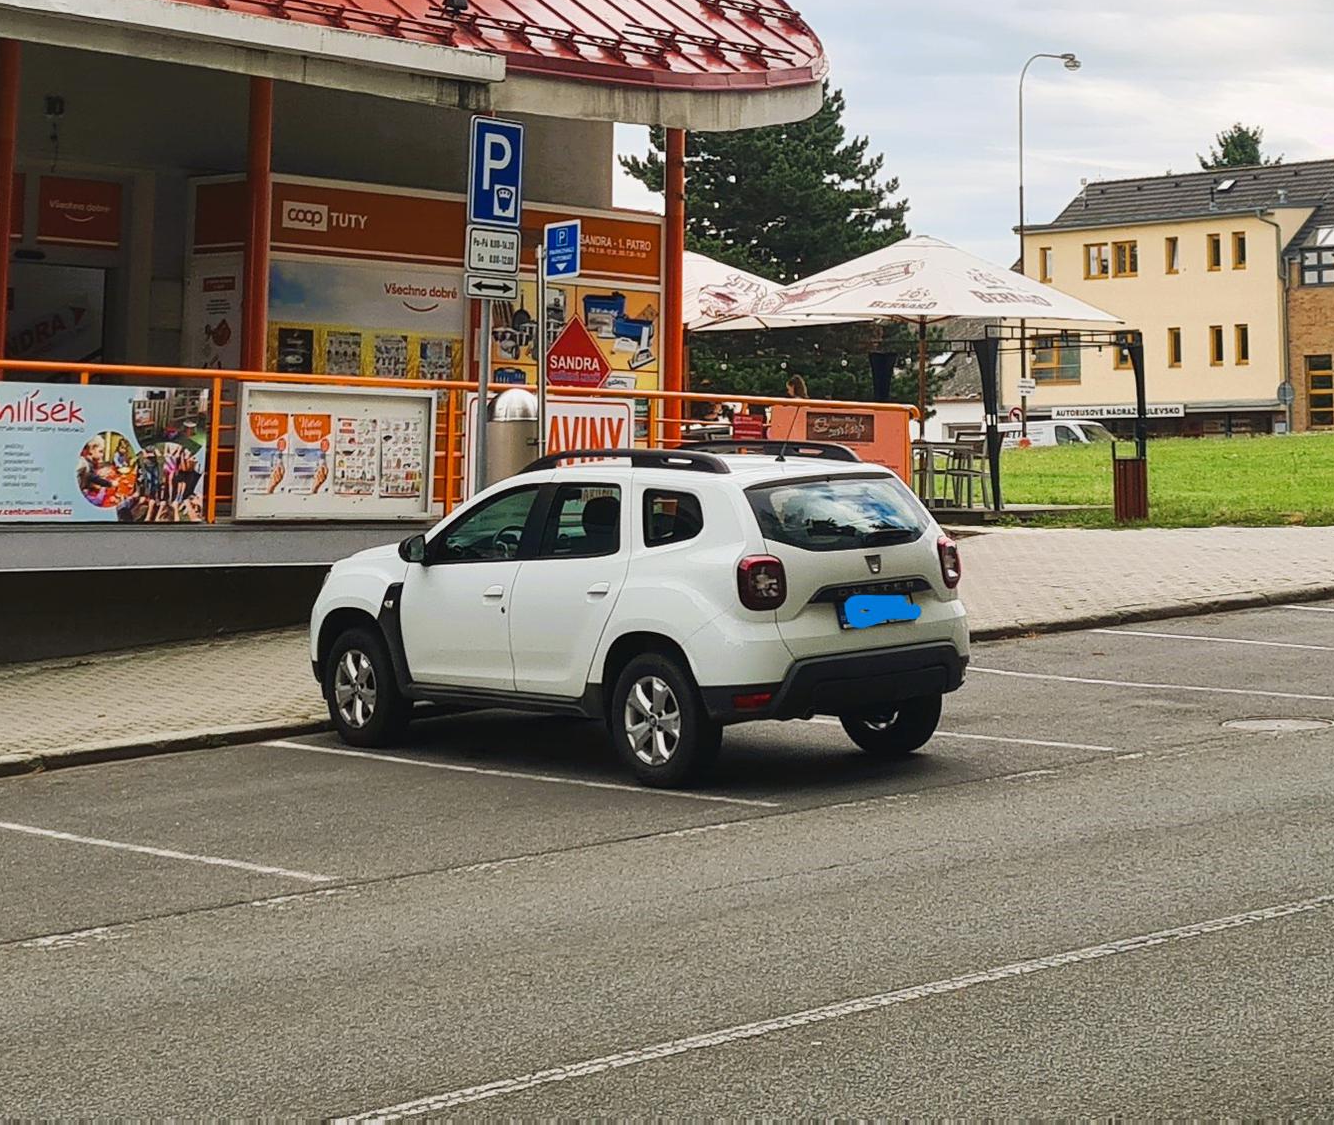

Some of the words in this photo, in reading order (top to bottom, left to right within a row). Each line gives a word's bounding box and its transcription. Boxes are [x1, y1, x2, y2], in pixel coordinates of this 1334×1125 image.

[482, 132, 512, 191] P
[287, 207, 323, 227] coop
[330, 212, 368, 229] TUTY
[579, 234, 613, 248] SANDRA
[626, 238, 652, 251] PATRO
[384, 282, 427, 297] Všechno
[429, 285, 458, 299] dobré
[549, 354, 600, 371] SANDRA
